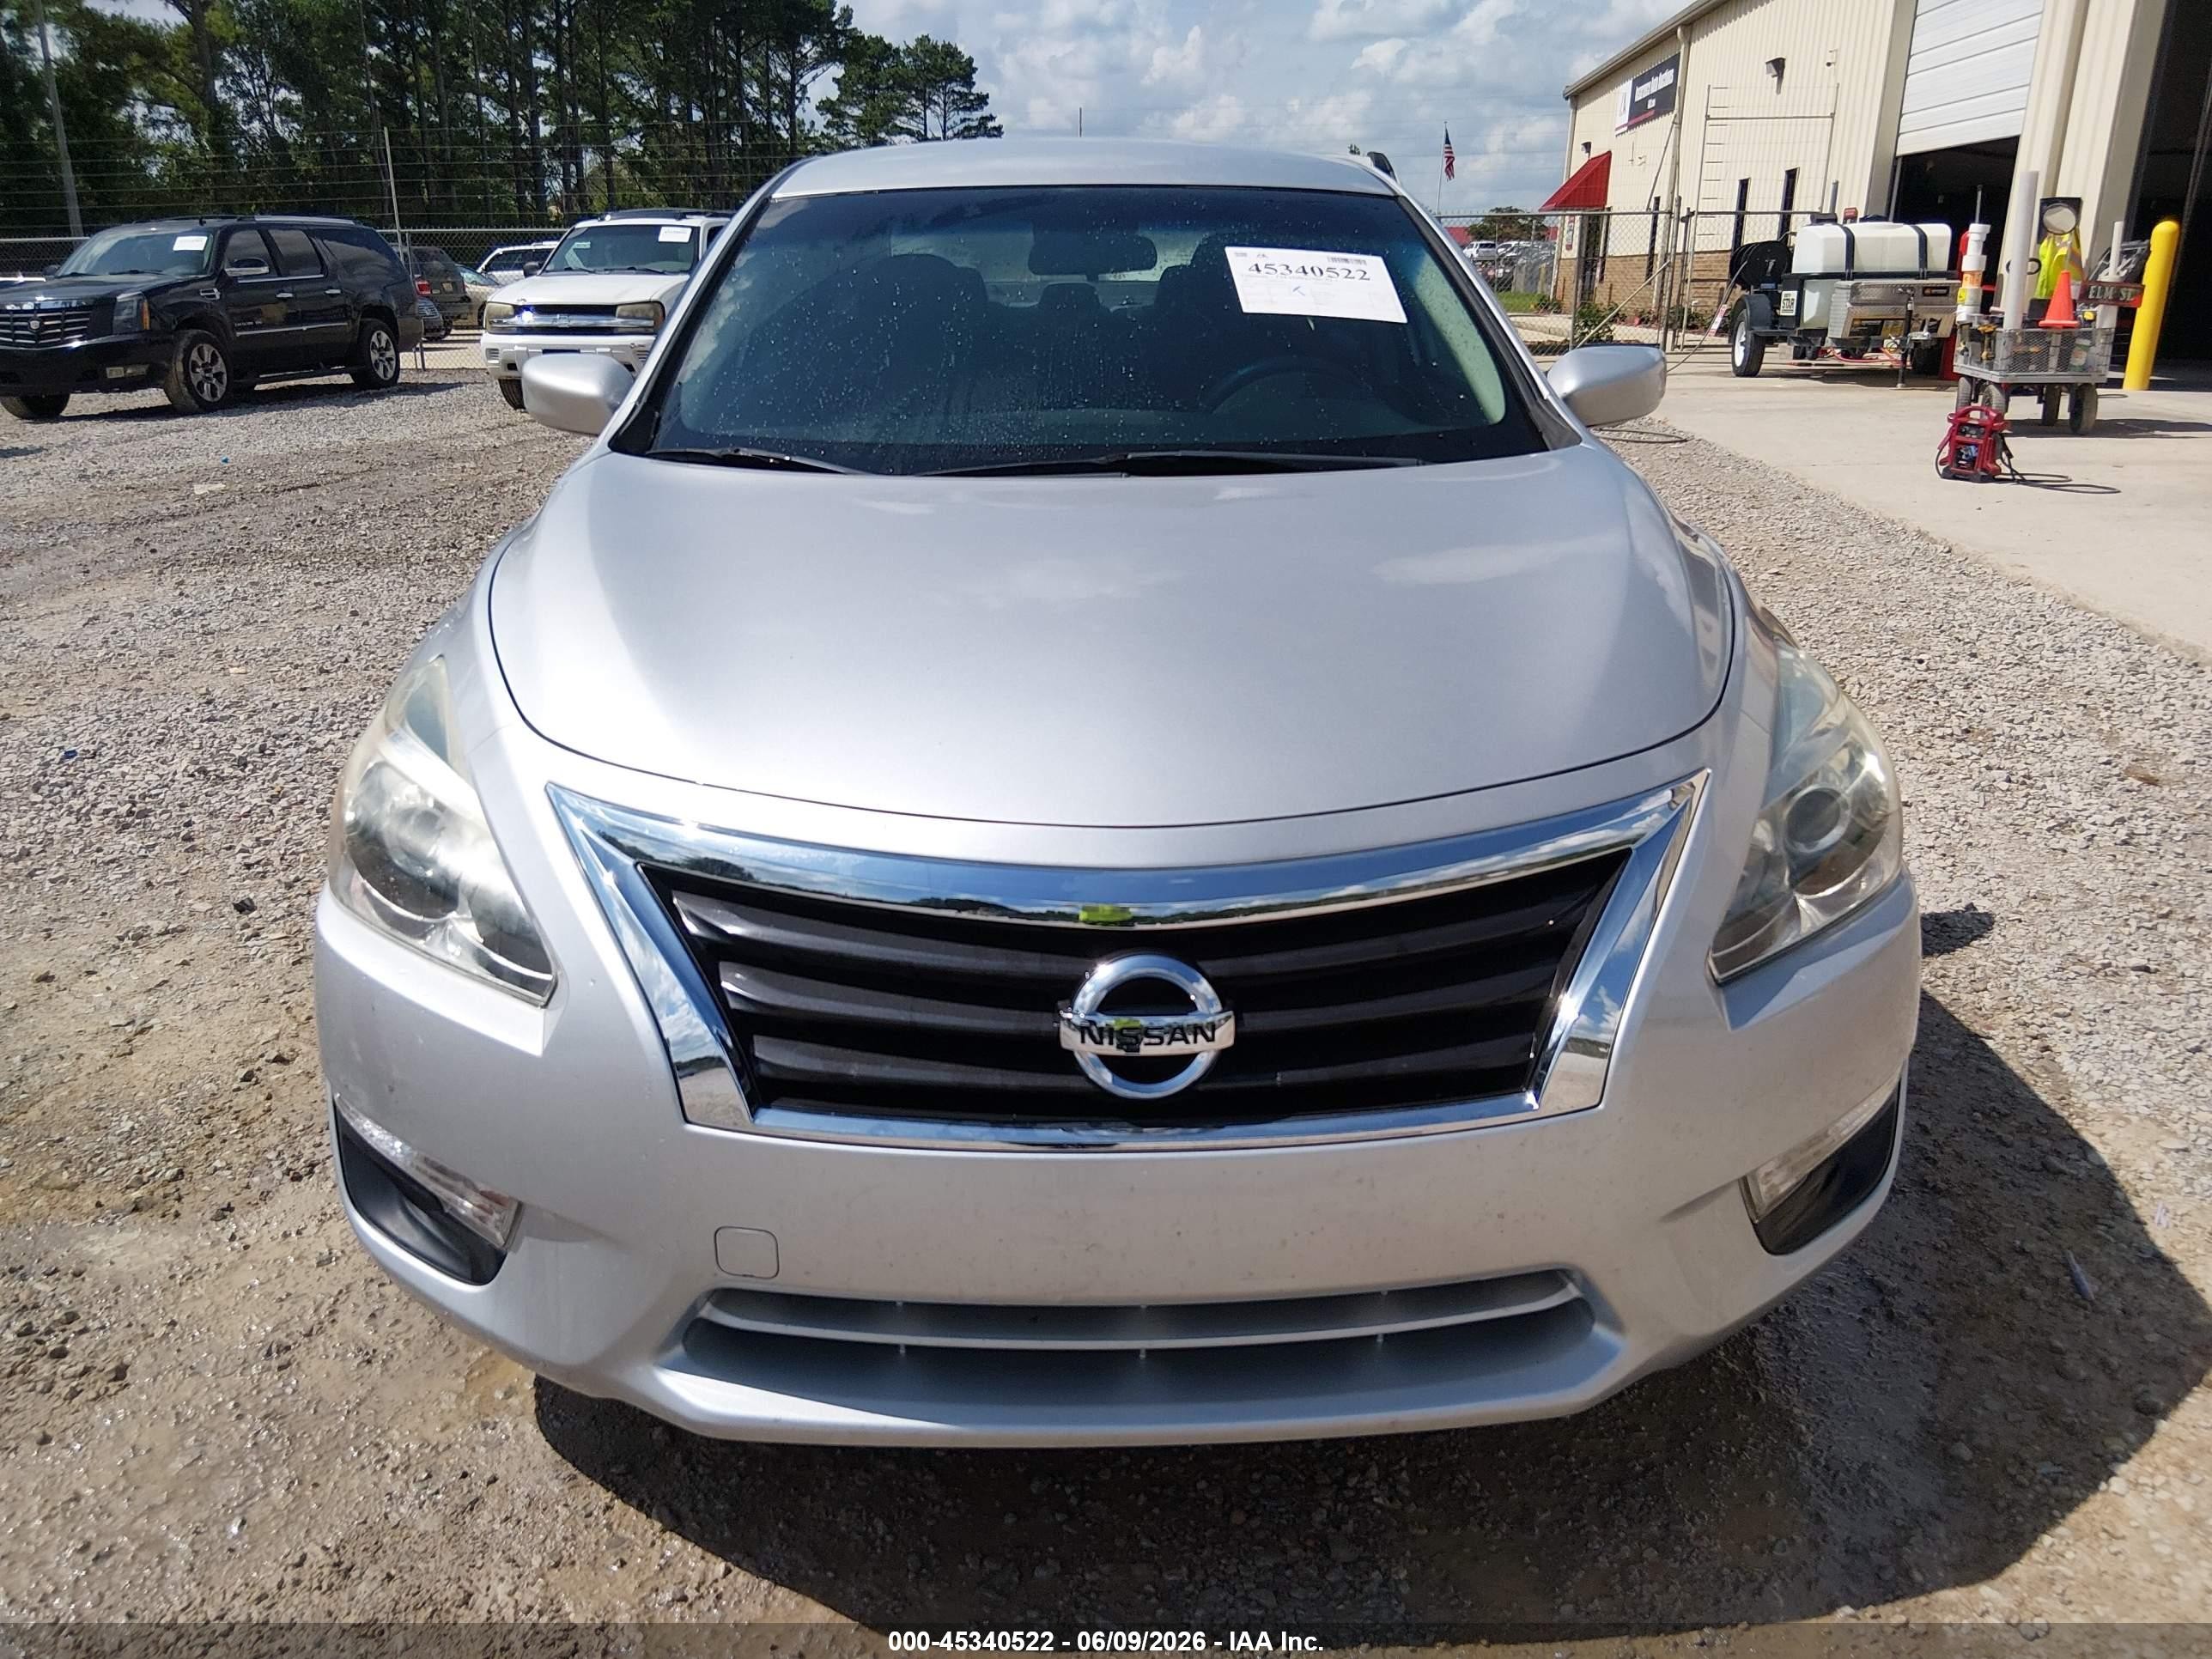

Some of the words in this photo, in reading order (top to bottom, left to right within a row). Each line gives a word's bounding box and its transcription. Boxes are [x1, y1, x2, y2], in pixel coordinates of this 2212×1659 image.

[1248, 262, 1371, 282] 45340522
[2088, 285, 2114, 300] ELM
[1079, 1020, 1217, 1047] NISSAN
